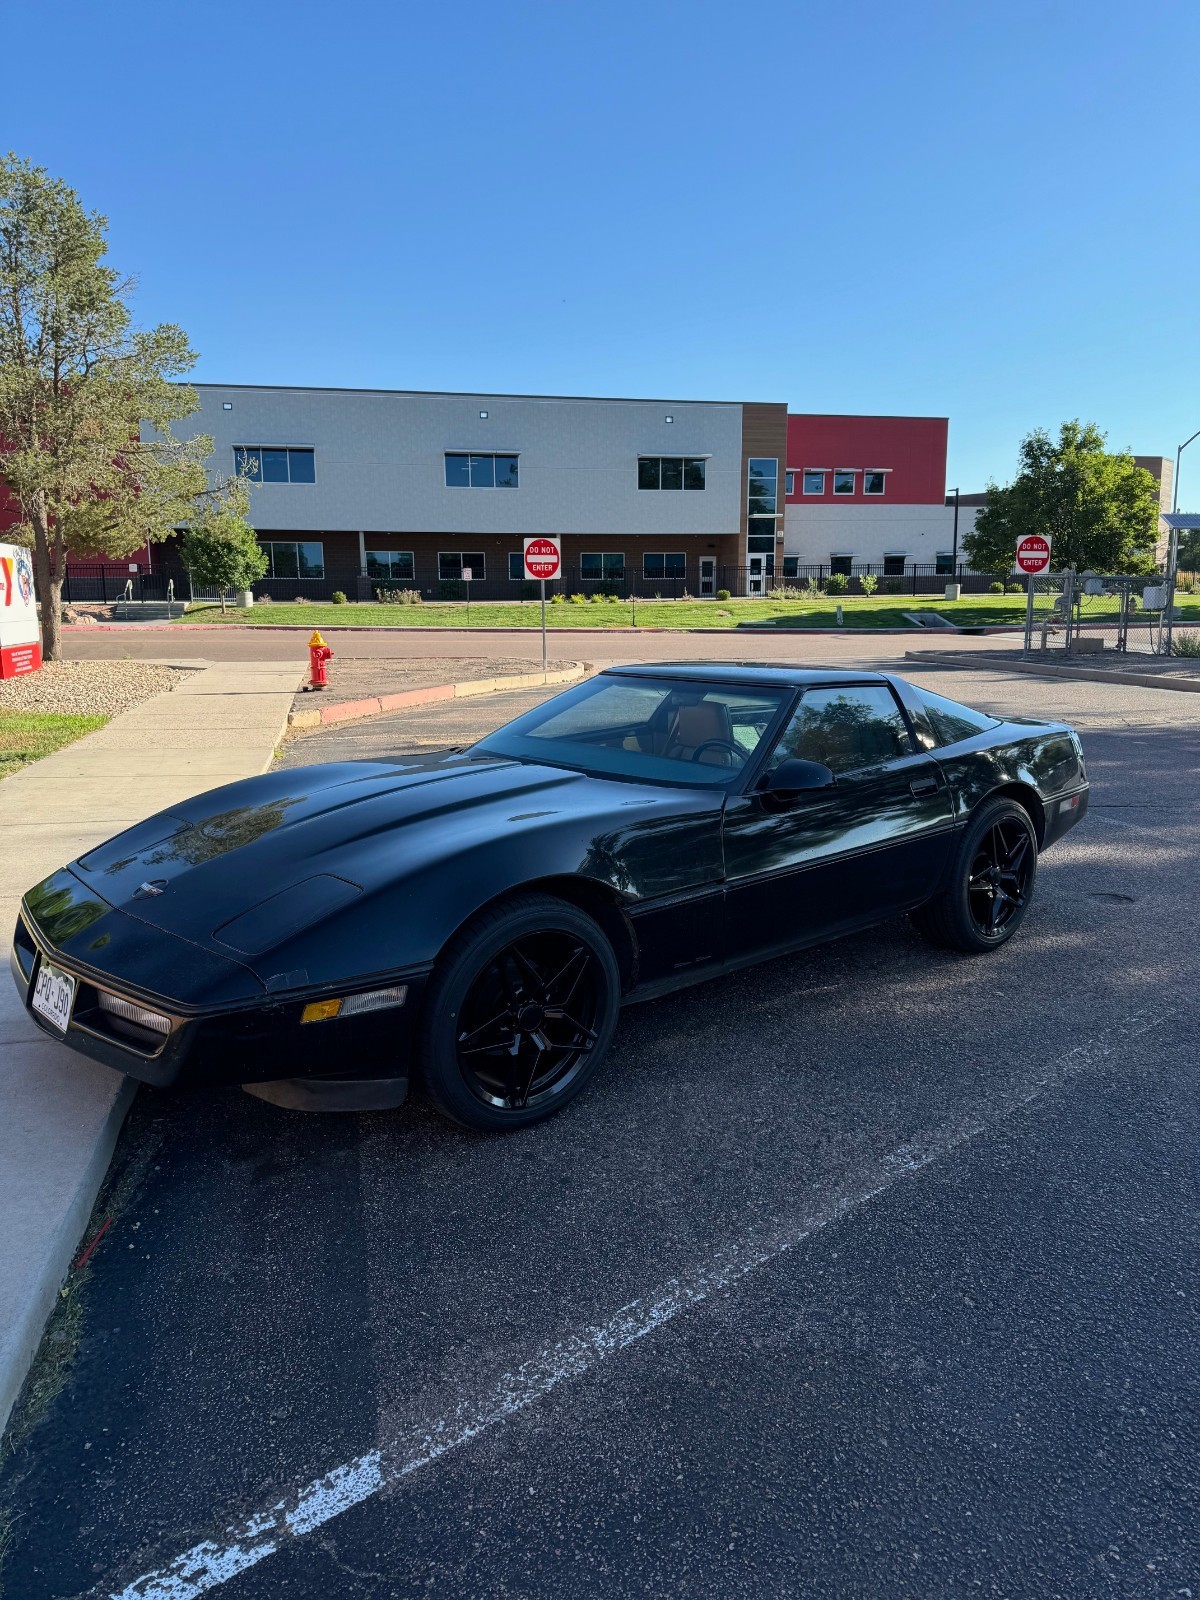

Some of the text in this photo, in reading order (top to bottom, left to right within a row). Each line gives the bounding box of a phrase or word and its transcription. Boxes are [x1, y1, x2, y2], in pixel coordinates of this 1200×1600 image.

[529, 546, 555, 554] DO NOT
[532, 564, 553, 572] ENTER
